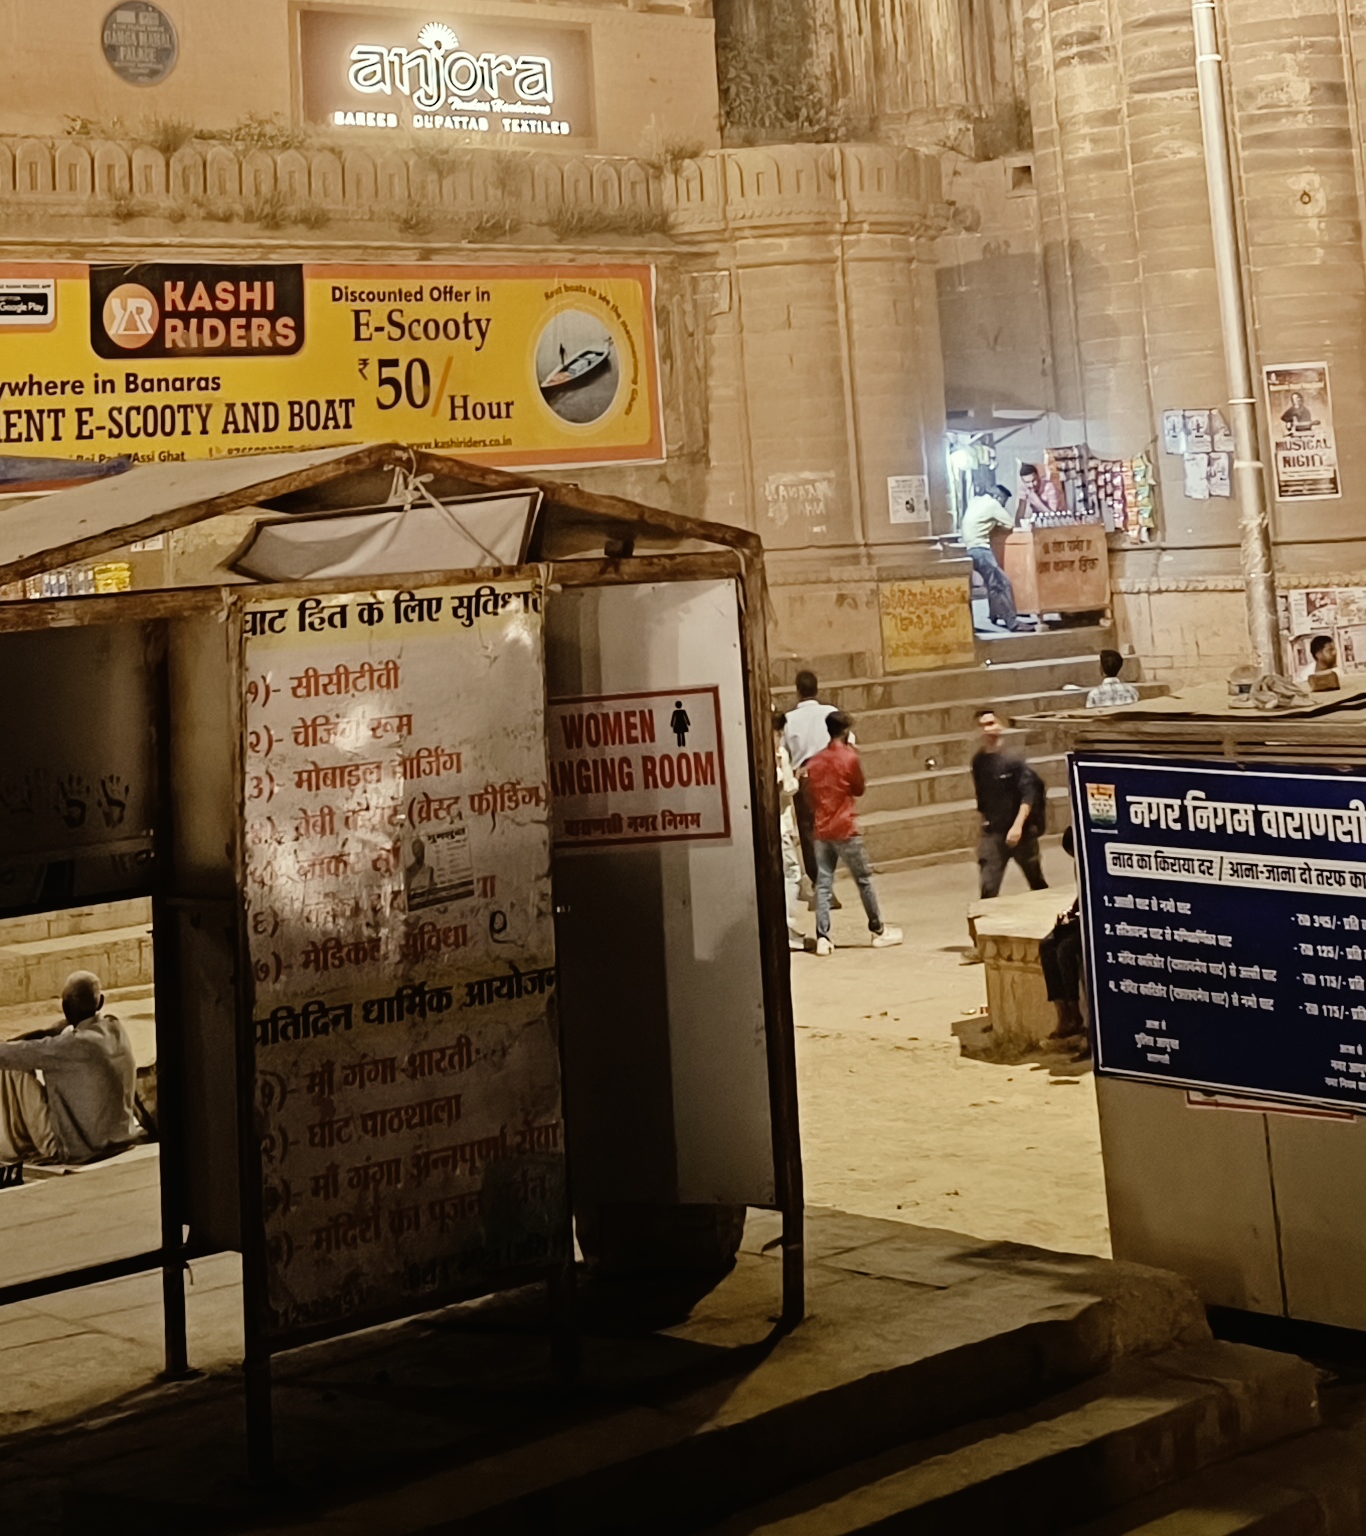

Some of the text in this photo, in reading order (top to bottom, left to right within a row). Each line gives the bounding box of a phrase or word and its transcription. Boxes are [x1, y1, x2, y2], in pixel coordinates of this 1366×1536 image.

[348, 42, 554, 111] anjora
[501, 117, 570, 135] TEXTILES
[0, 302, 44, 313] Google Play
[164, 281, 274, 312] KASHI
[331, 286, 490, 303] Discounted Offer in
[164, 316, 296, 349] RIDERS
[351, 308, 492, 352] E-Scooty
[93, 373, 115, 395] in
[125, 373, 221, 394] Banaras
[75, 402, 213, 441] E-SCOOTY
[221, 401, 279, 435] AND
[288, 398, 355, 433] BOAT
[448, 395, 514, 422] Hour
[243, 608, 288, 637] घाट
[297, 598, 349, 632] हित
[392, 590, 443, 624] लिए
[289, 659, 401, 699] सीसीटीवी
[560, 709, 655, 750] WOMEN
[641, 751, 716, 789] ROOM
[627, 814, 658, 832] नगर
[660, 809, 701, 830] निगम
[1125, 795, 1182, 831] नगर
[1183, 790, 1256, 837] निगम
[1109, 850, 1134, 869] नाव
[1134, 852, 1153, 871] का
[1154, 849, 1195, 874] किराया
[1195, 856, 1214, 877] दर
[1227, 860, 1296, 884] आना-जाना
[1297, 862, 1313, 884] दो
[1314, 867, 1347, 887] तरफ
[362, 981, 453, 1025] धार्मिक
[342, 1052, 396, 1089] गंगा
